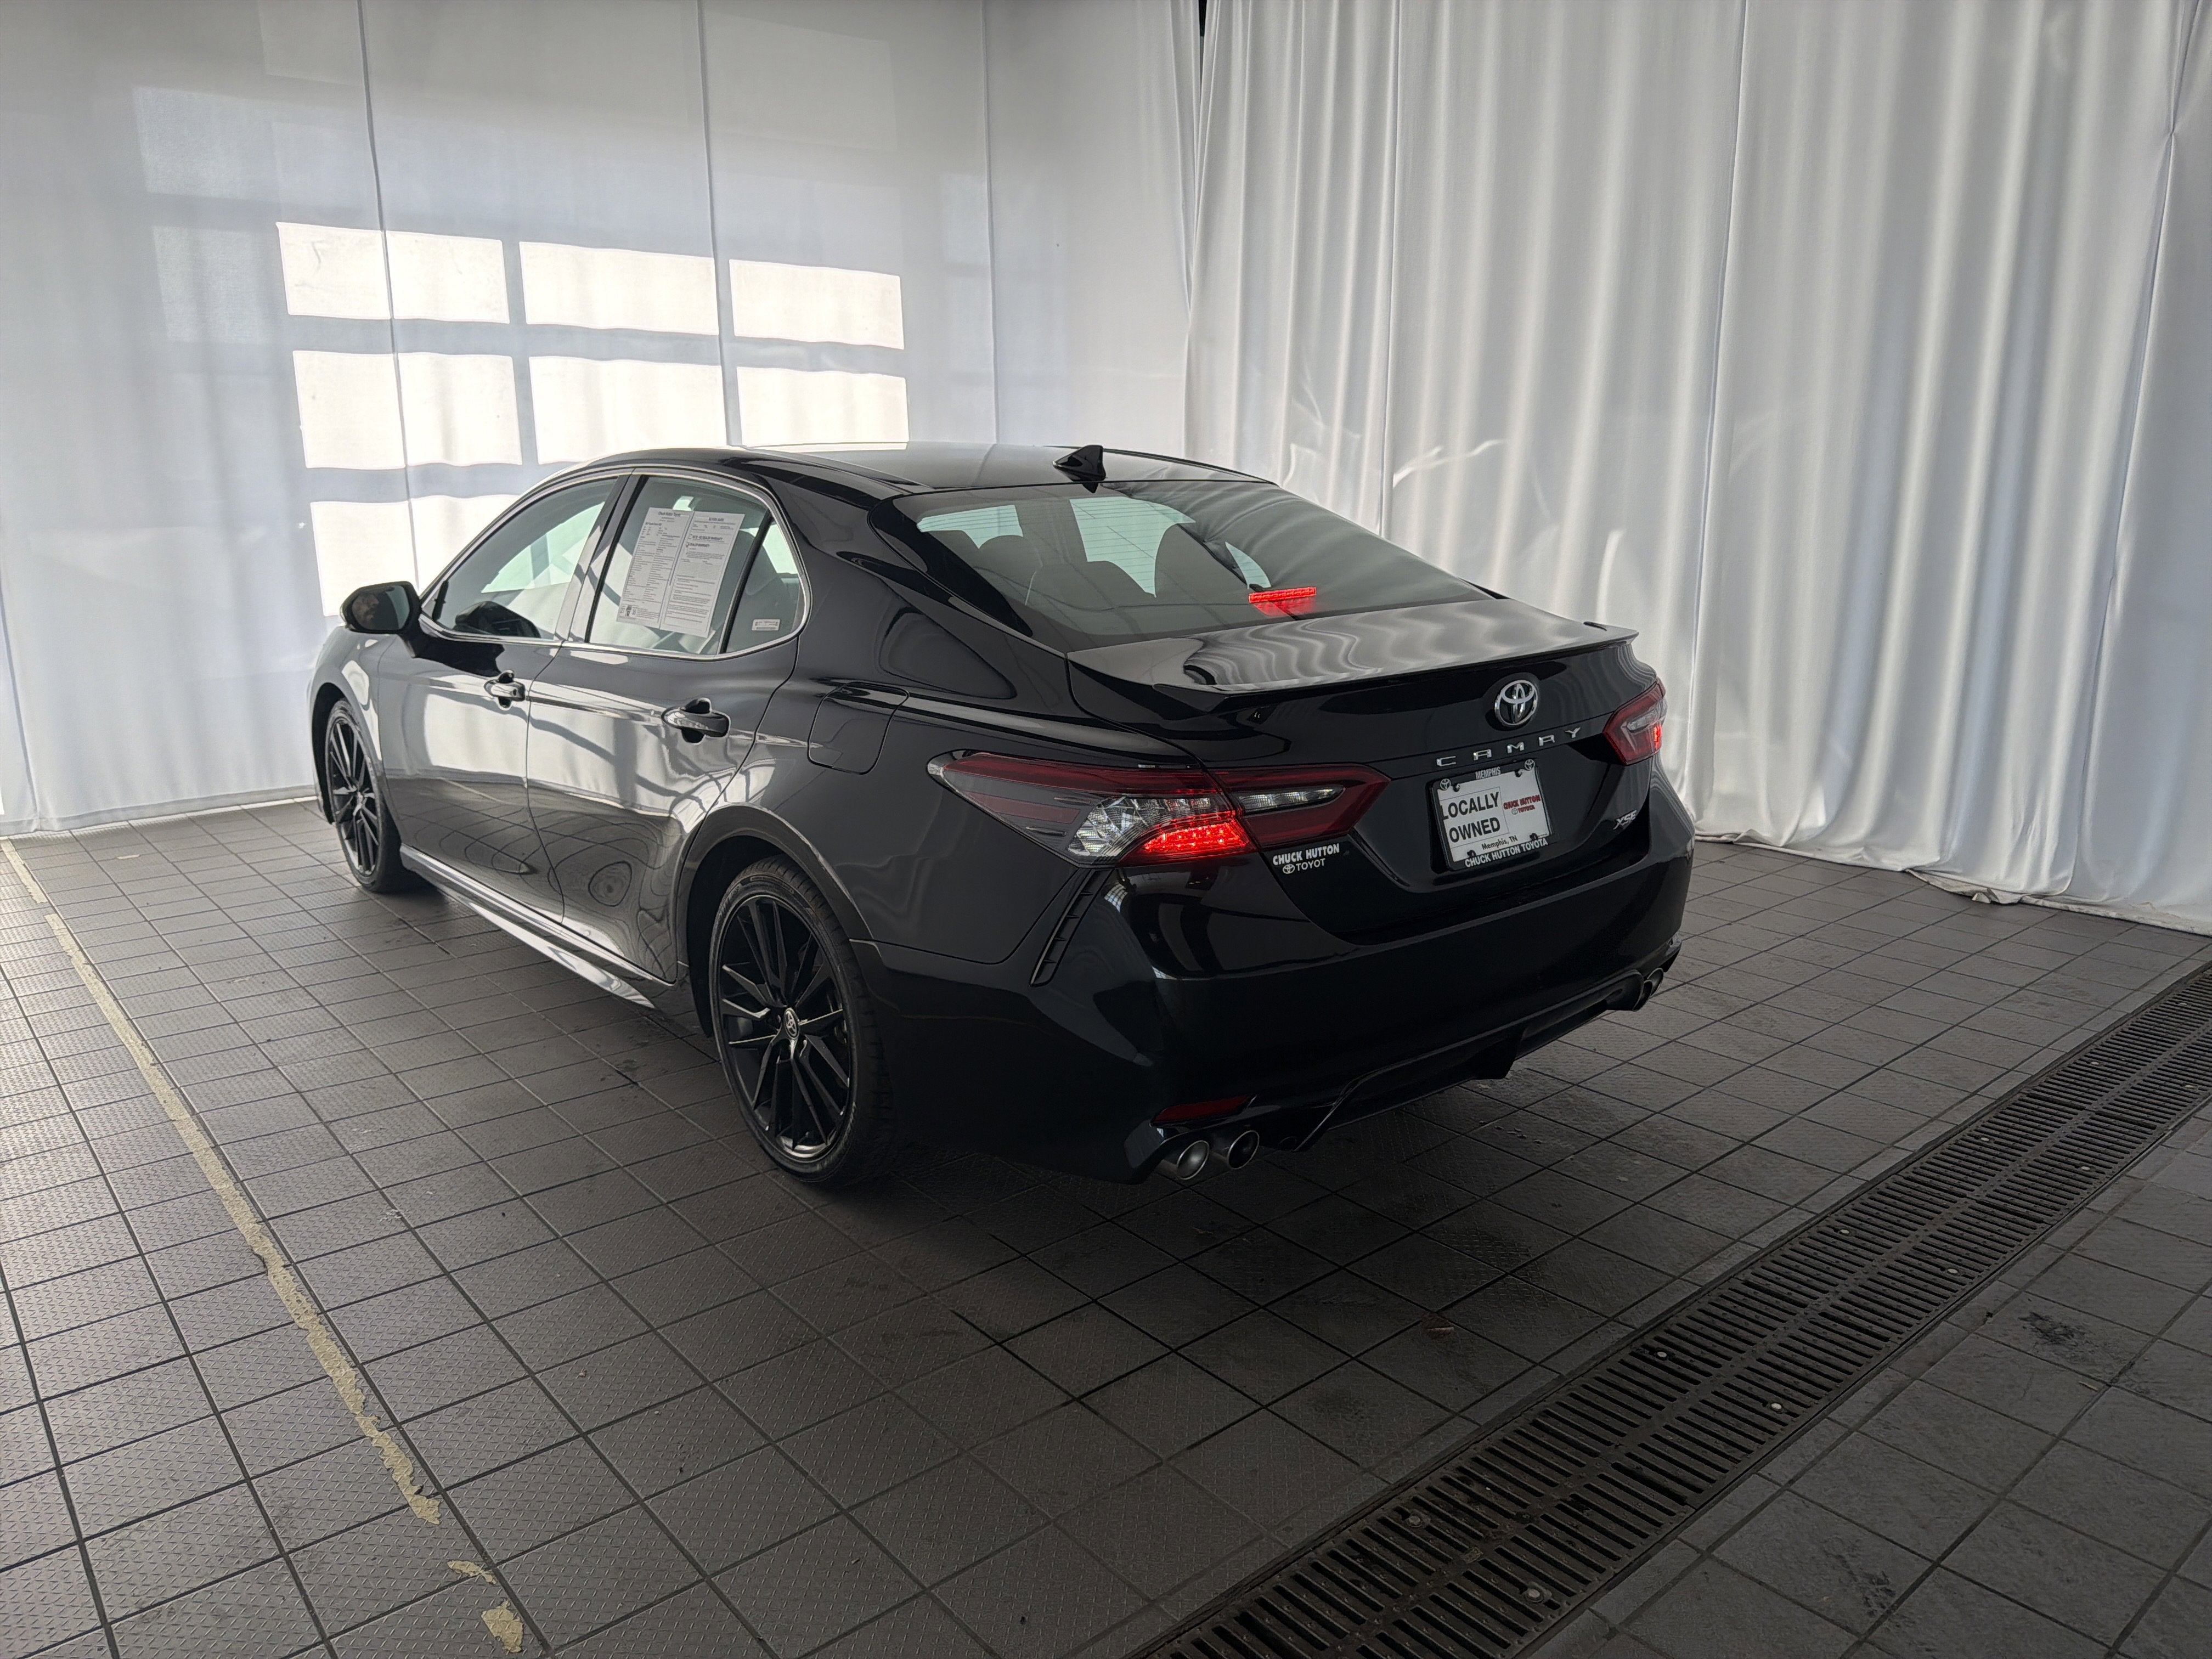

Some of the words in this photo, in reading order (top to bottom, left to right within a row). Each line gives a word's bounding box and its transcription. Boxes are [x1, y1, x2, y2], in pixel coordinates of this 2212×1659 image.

[1436, 727, 1581, 766] CAMRY
[1475, 766, 1501, 780] MEMPHIS
[1440, 792, 1499, 820] LOCALLY
[1503, 799, 1519, 810] CHUCK
[1519, 794, 1541, 806] HUTTON
[1518, 805, 1535, 813] TOYOTA
[1449, 817, 1500, 843] OWNED
[1613, 809, 1637, 830] XSE
[1273, 851, 1303, 865] CHUCK
[1306, 843, 1340, 859] HUTTON
[1465, 853, 1491, 867] CHUCK
[1492, 847, 1521, 860] HUTTON
[1522, 838, 1548, 851] TOYOTA
[1482, 838, 1509, 850] Memphis,
[1296, 858, 1325, 871] TOYOT
